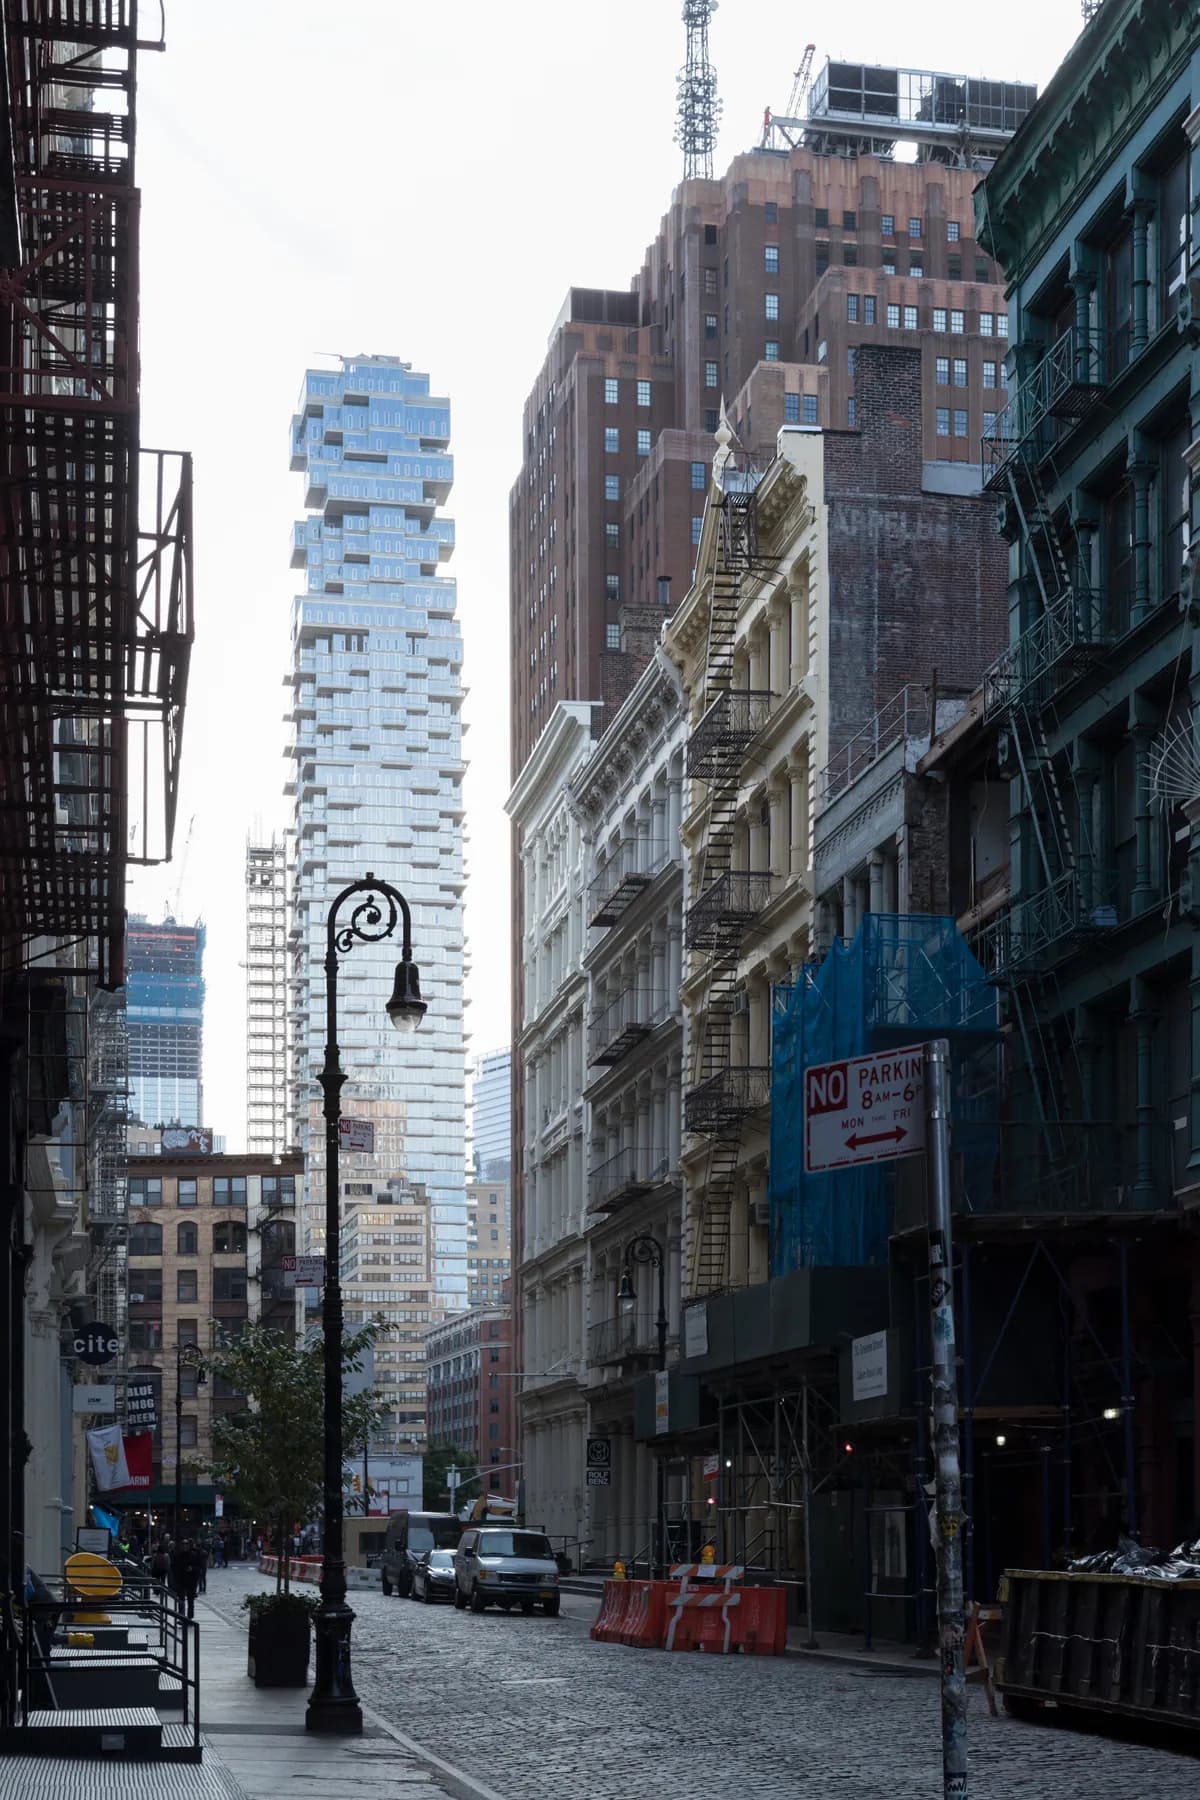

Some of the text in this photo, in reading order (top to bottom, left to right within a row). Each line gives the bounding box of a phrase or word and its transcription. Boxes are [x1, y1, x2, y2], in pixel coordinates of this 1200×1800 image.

[809, 1057, 922, 1109] NO PARKIN
[861, 1083, 922, 1110] 8AM-6P
[340, 1120, 350, 1133] NO
[841, 1117, 864, 1130] MON
[893, 1108, 911, 1121] FRI
[284, 1257, 295, 1270] NO
[74, 1334, 119, 1353] cite
[127, 1385, 154, 1397] BLUE
